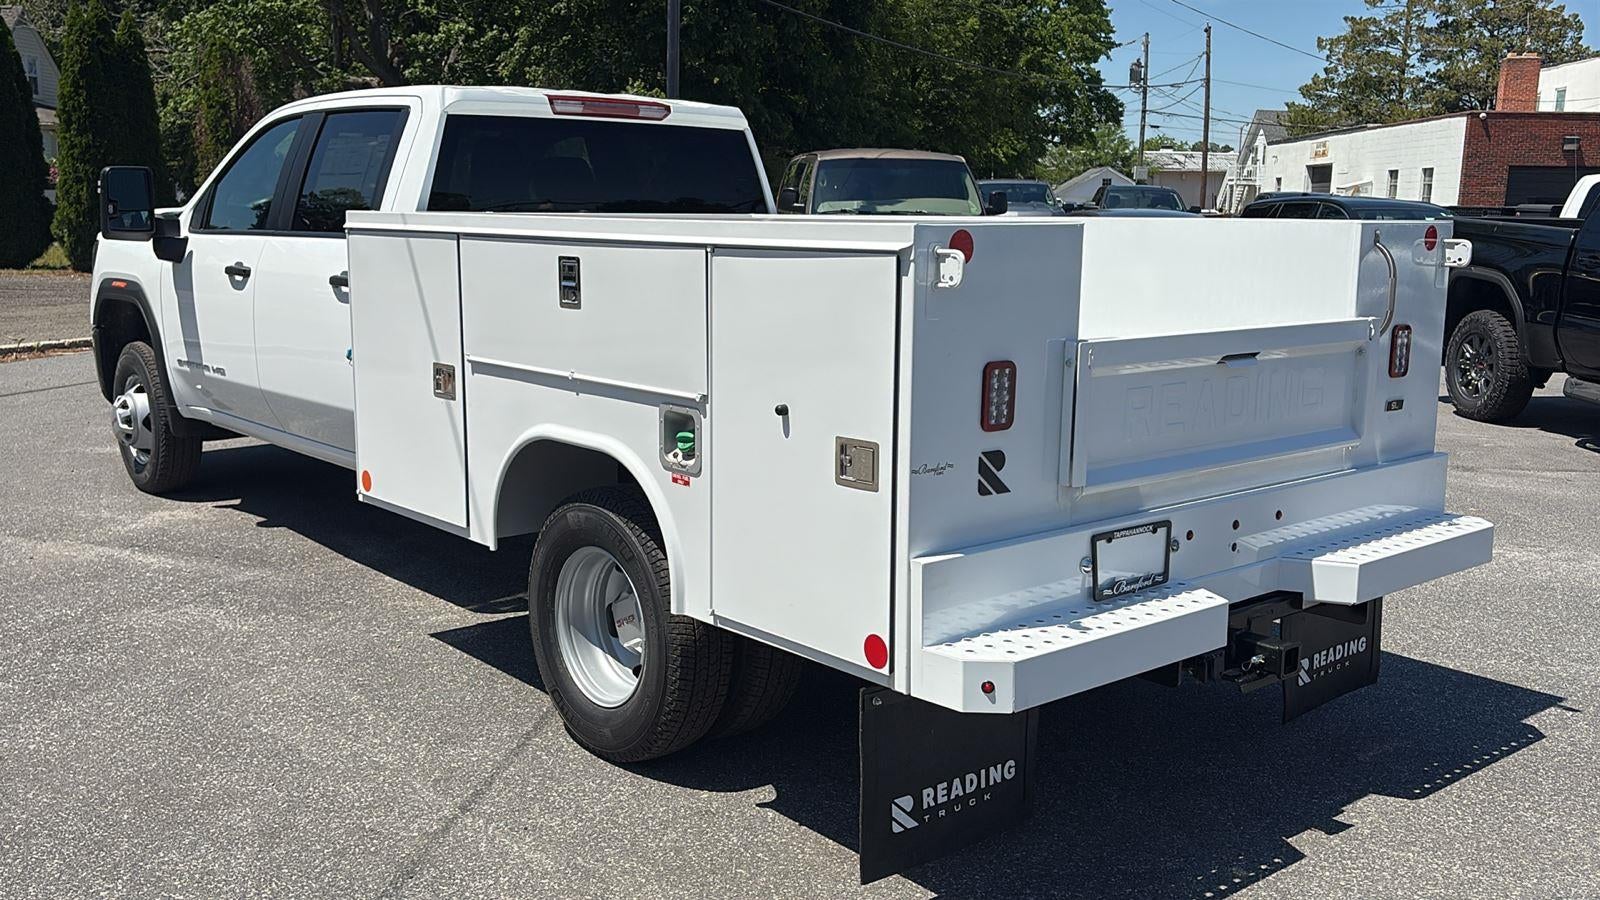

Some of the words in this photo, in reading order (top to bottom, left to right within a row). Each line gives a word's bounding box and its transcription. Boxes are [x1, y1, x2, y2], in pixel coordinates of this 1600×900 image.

[1121, 367, 1326, 441] READING
[1113, 524, 1154, 538] TAPPAHANNOCK
[1113, 572, 1155, 595] Bareford
[1312, 636, 1367, 670] READING
[1312, 660, 1350, 680] TRUCK
[921, 759, 1016, 810] READING
[923, 792, 991, 823] TRUCK
